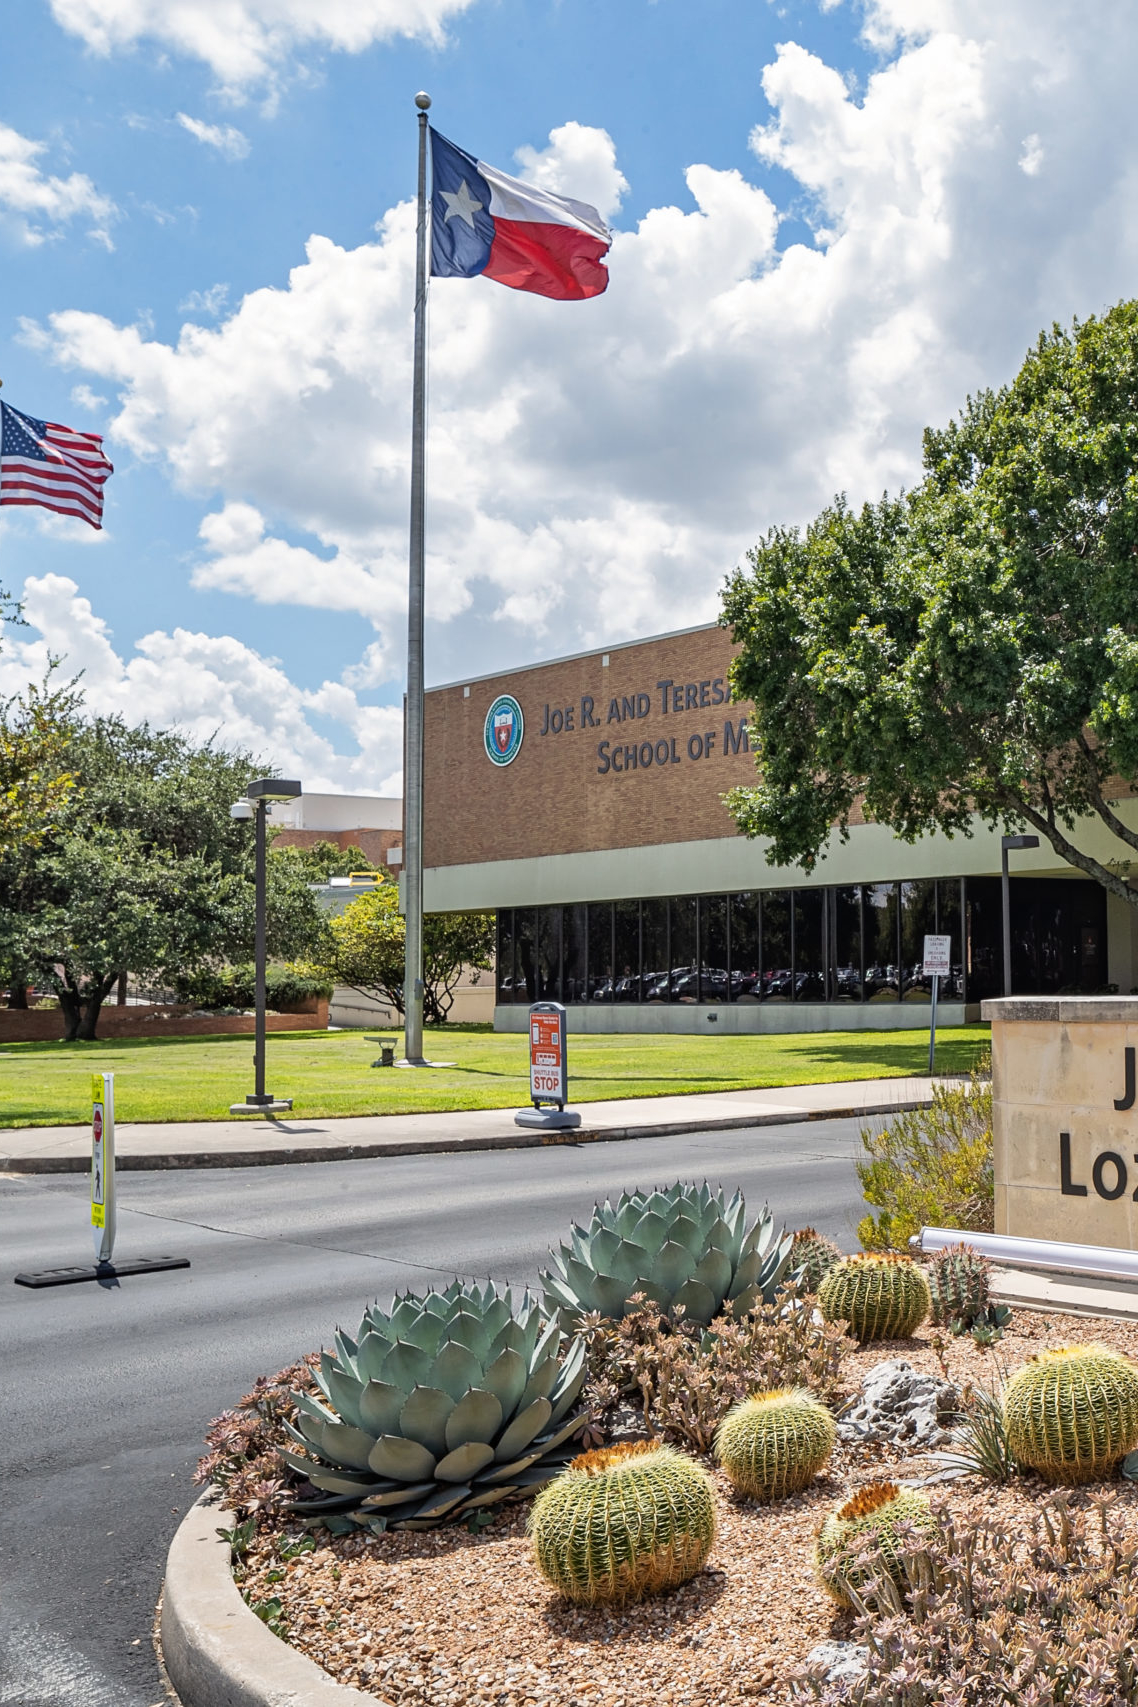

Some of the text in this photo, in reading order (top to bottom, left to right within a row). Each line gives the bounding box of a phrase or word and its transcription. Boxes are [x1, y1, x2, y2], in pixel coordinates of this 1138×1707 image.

[540, 704, 574, 736] JOE
[581, 695, 600, 729] R.
[606, 693, 650, 724] AND
[597, 738, 680, 774] SCHOOL
[687, 731, 716, 760] OF
[534, 1076, 560, 1091] STOP
